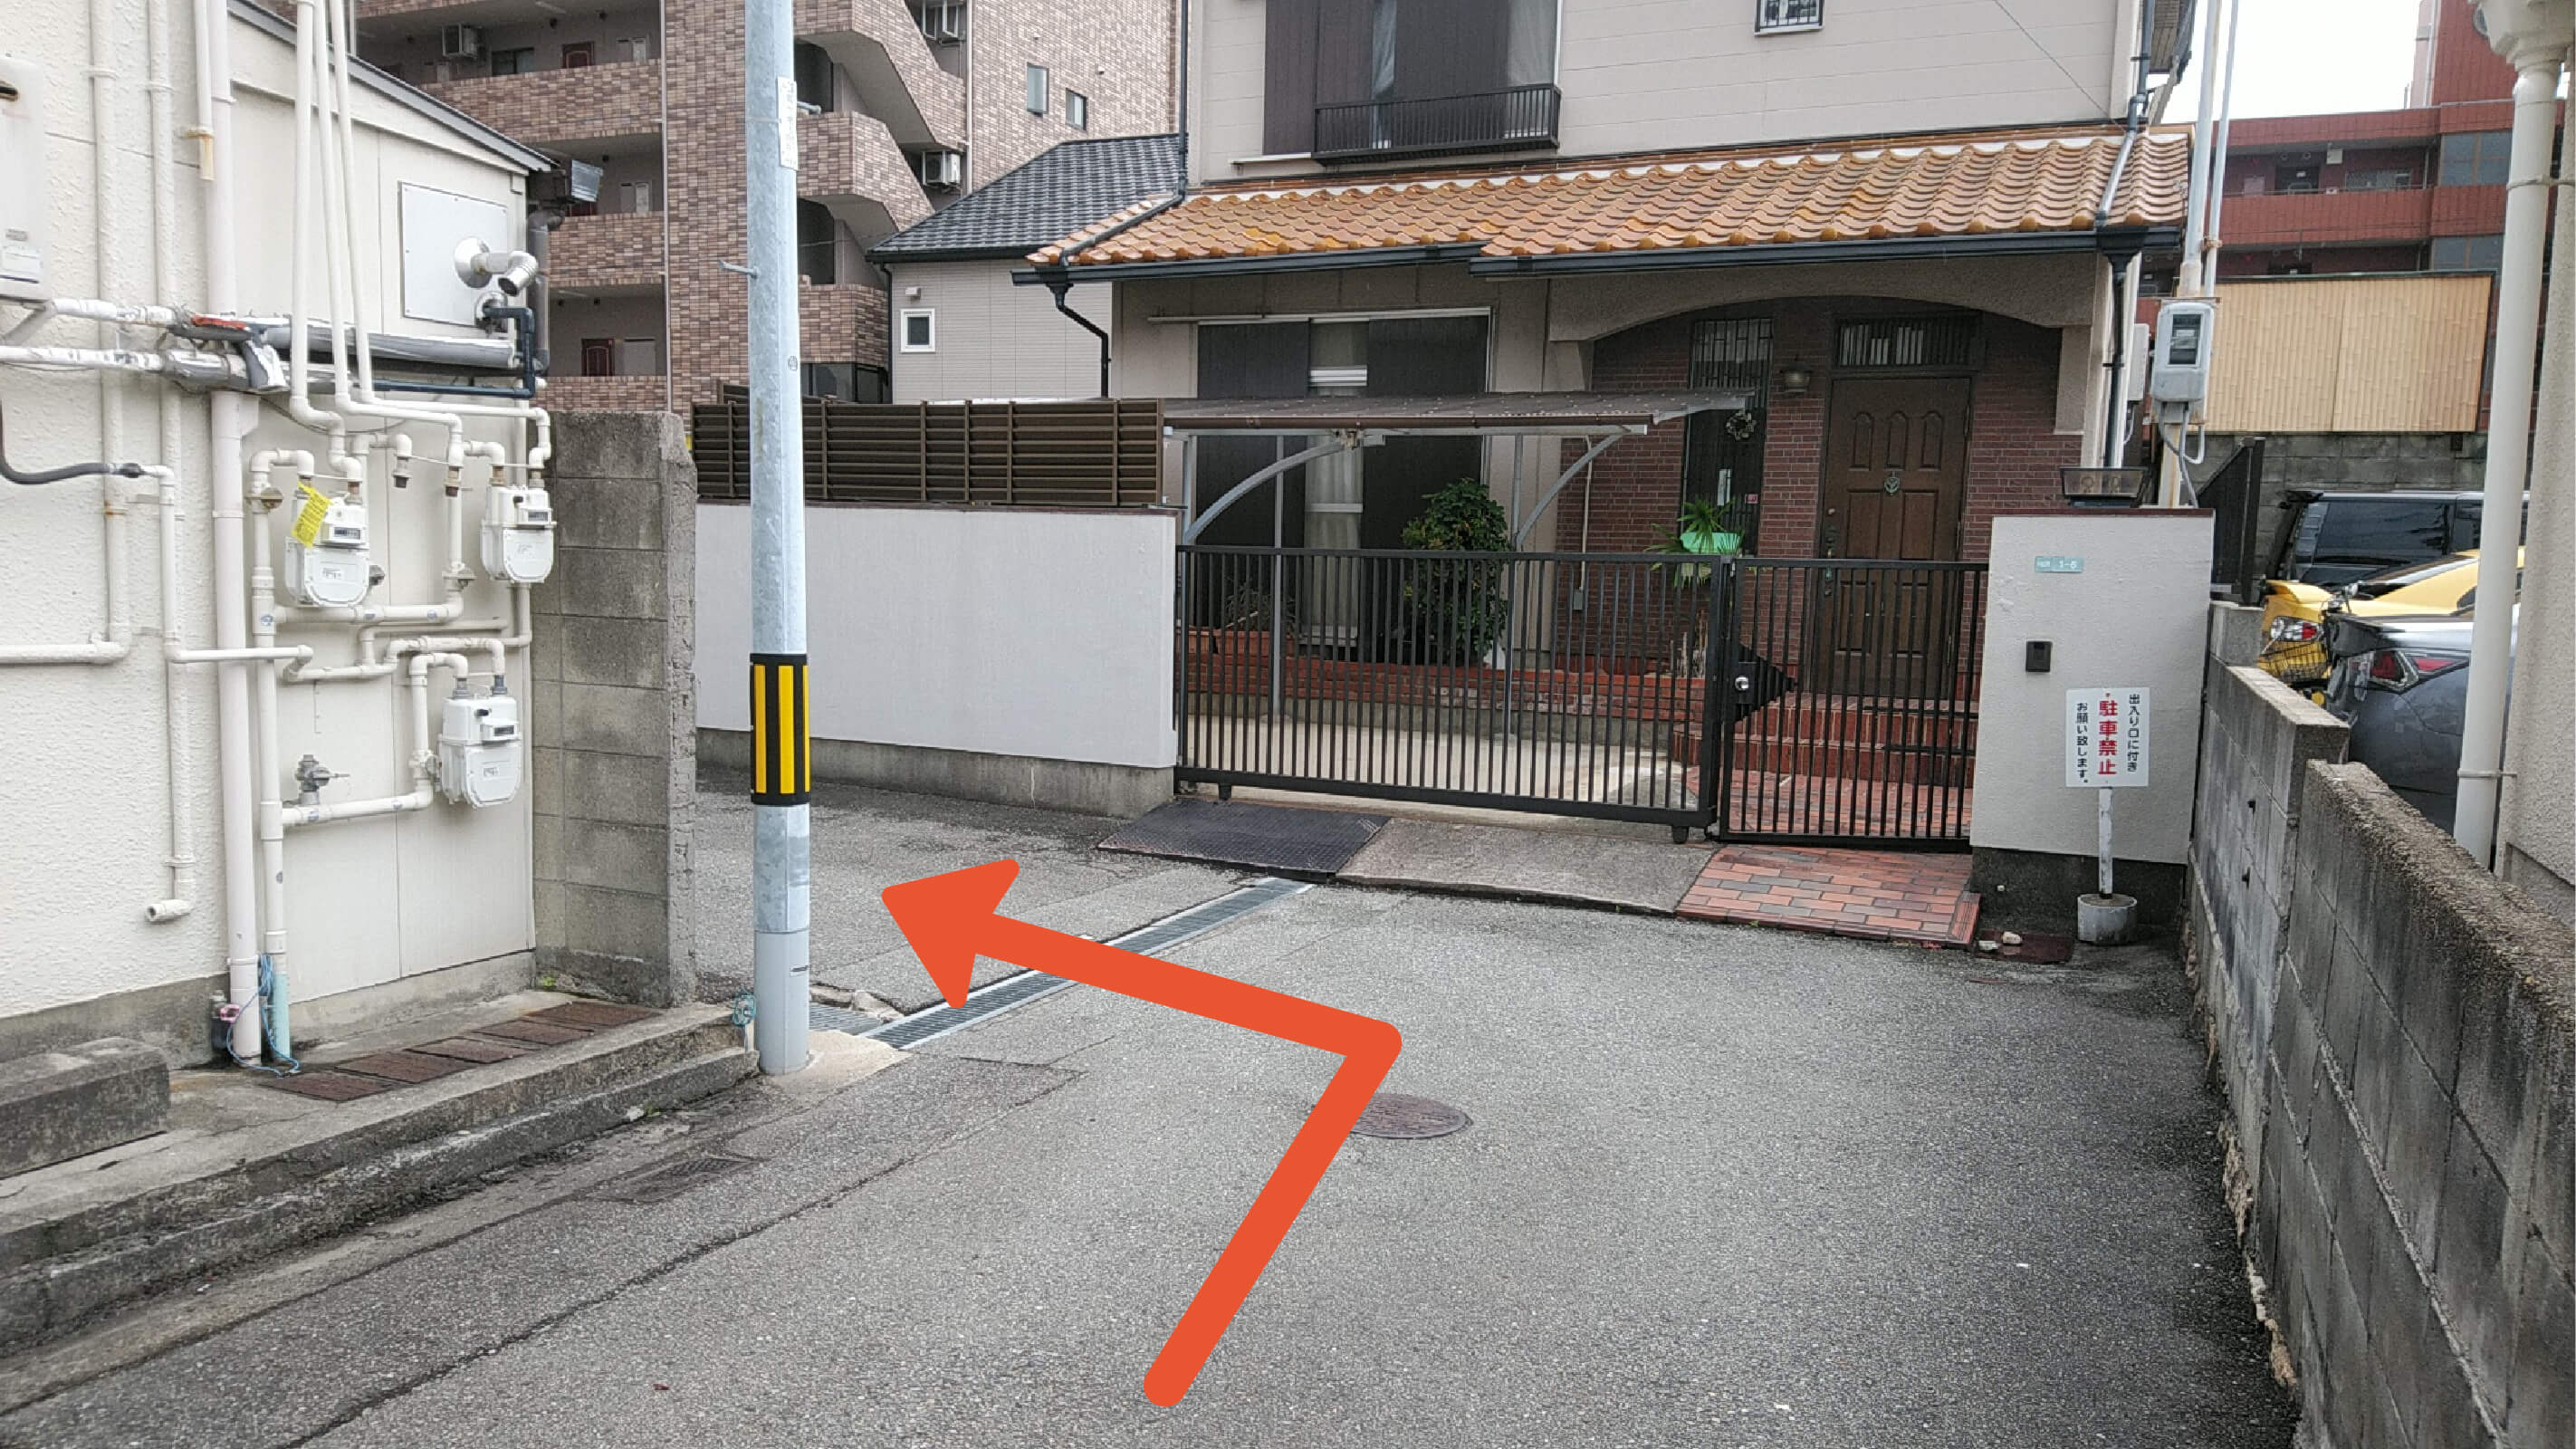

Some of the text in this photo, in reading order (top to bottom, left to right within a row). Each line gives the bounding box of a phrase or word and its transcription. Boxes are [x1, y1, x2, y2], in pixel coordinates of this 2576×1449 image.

[2098, 699, 2118, 775] 駐車禁止
[2126, 694, 2140, 772] 出入り口に付き
